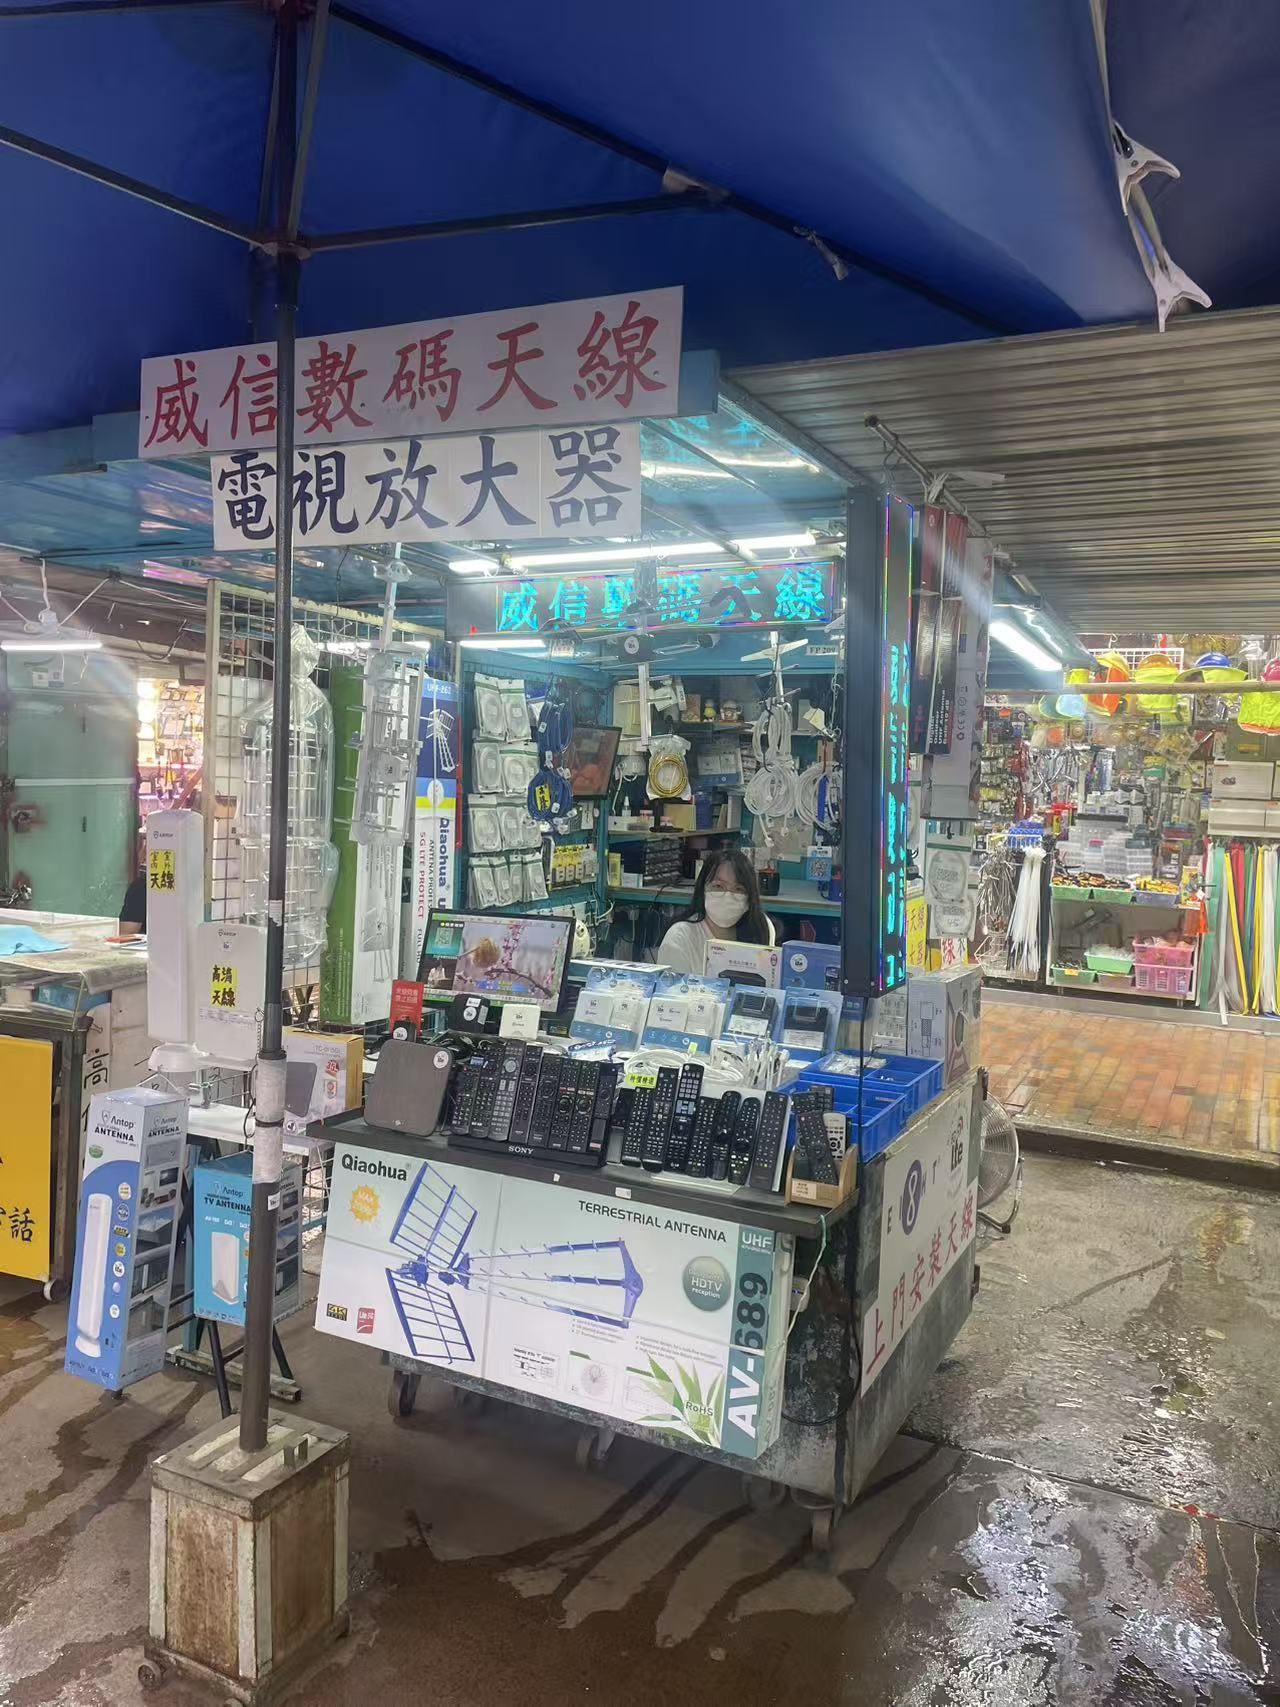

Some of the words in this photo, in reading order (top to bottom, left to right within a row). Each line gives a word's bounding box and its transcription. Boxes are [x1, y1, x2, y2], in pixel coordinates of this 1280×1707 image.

[144, 300, 667, 449] 威信數碼天線
[217, 425, 632, 541] 電視放大器
[438, 818, 449, 887] Qiaohua
[150, 871, 175, 889] 天線
[212, 964, 233, 984] 高清
[212, 988, 236, 1008] 天線
[111, 1115, 135, 1130] Antop
[94, 1126, 135, 1142] ANTENNA
[508, 1146, 534, 1155] SONY
[341, 1153, 407, 1181] Qiaohua
[204, 1196, 215, 1206] TV
[578, 1200, 662, 1228] TERRESTRIAL
[664, 1219, 727, 1242] ANTENNA
[742, 1231, 772, 1248] UHF
[691, 1276, 722, 1292] HDTV
[866, 1190, 974, 1375] 上門安裝天線
[692, 1287, 721, 1299] reception
[728, 1272, 768, 1439] AV-689
[685, 1401, 714, 1417] RoHS
